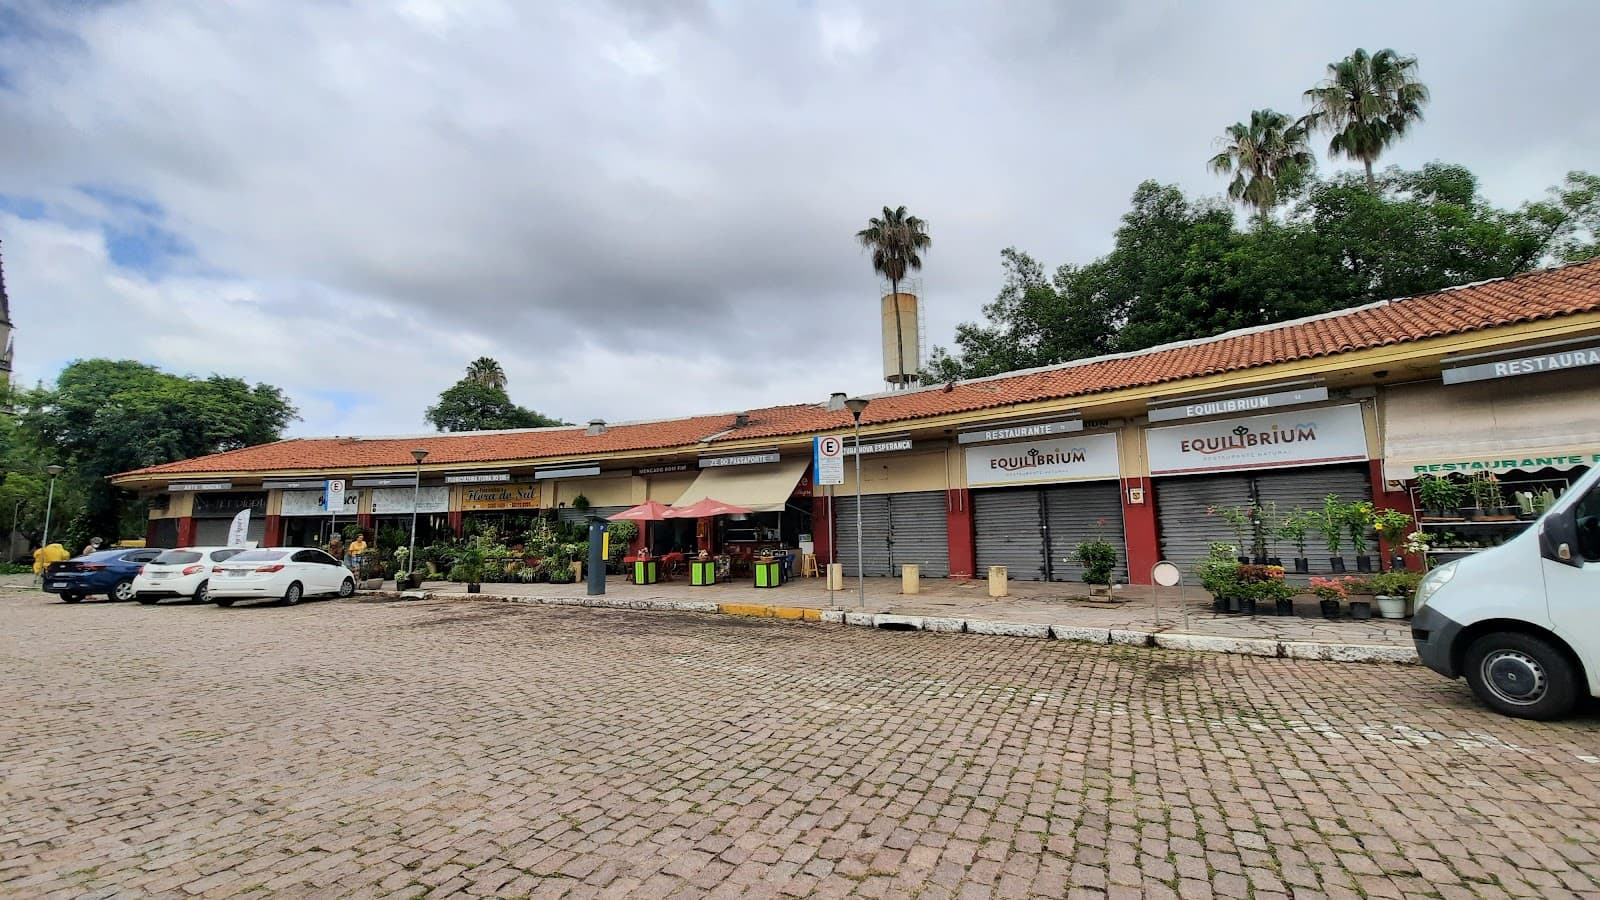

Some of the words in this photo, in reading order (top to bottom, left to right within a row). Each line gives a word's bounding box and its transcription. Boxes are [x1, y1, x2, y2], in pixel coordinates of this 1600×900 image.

[1186, 397, 1269, 417] EQUILIBRIUM
[985, 424, 1052, 440] RESTAURANTE
[1180, 421, 1317, 455] EQUILIBRIUM
[826, 441, 834, 453] E
[990, 448, 1086, 471] EQUILIBRIUM
[1414, 455, 1585, 473] RESTAURANTE
[333, 482, 340, 491] E
